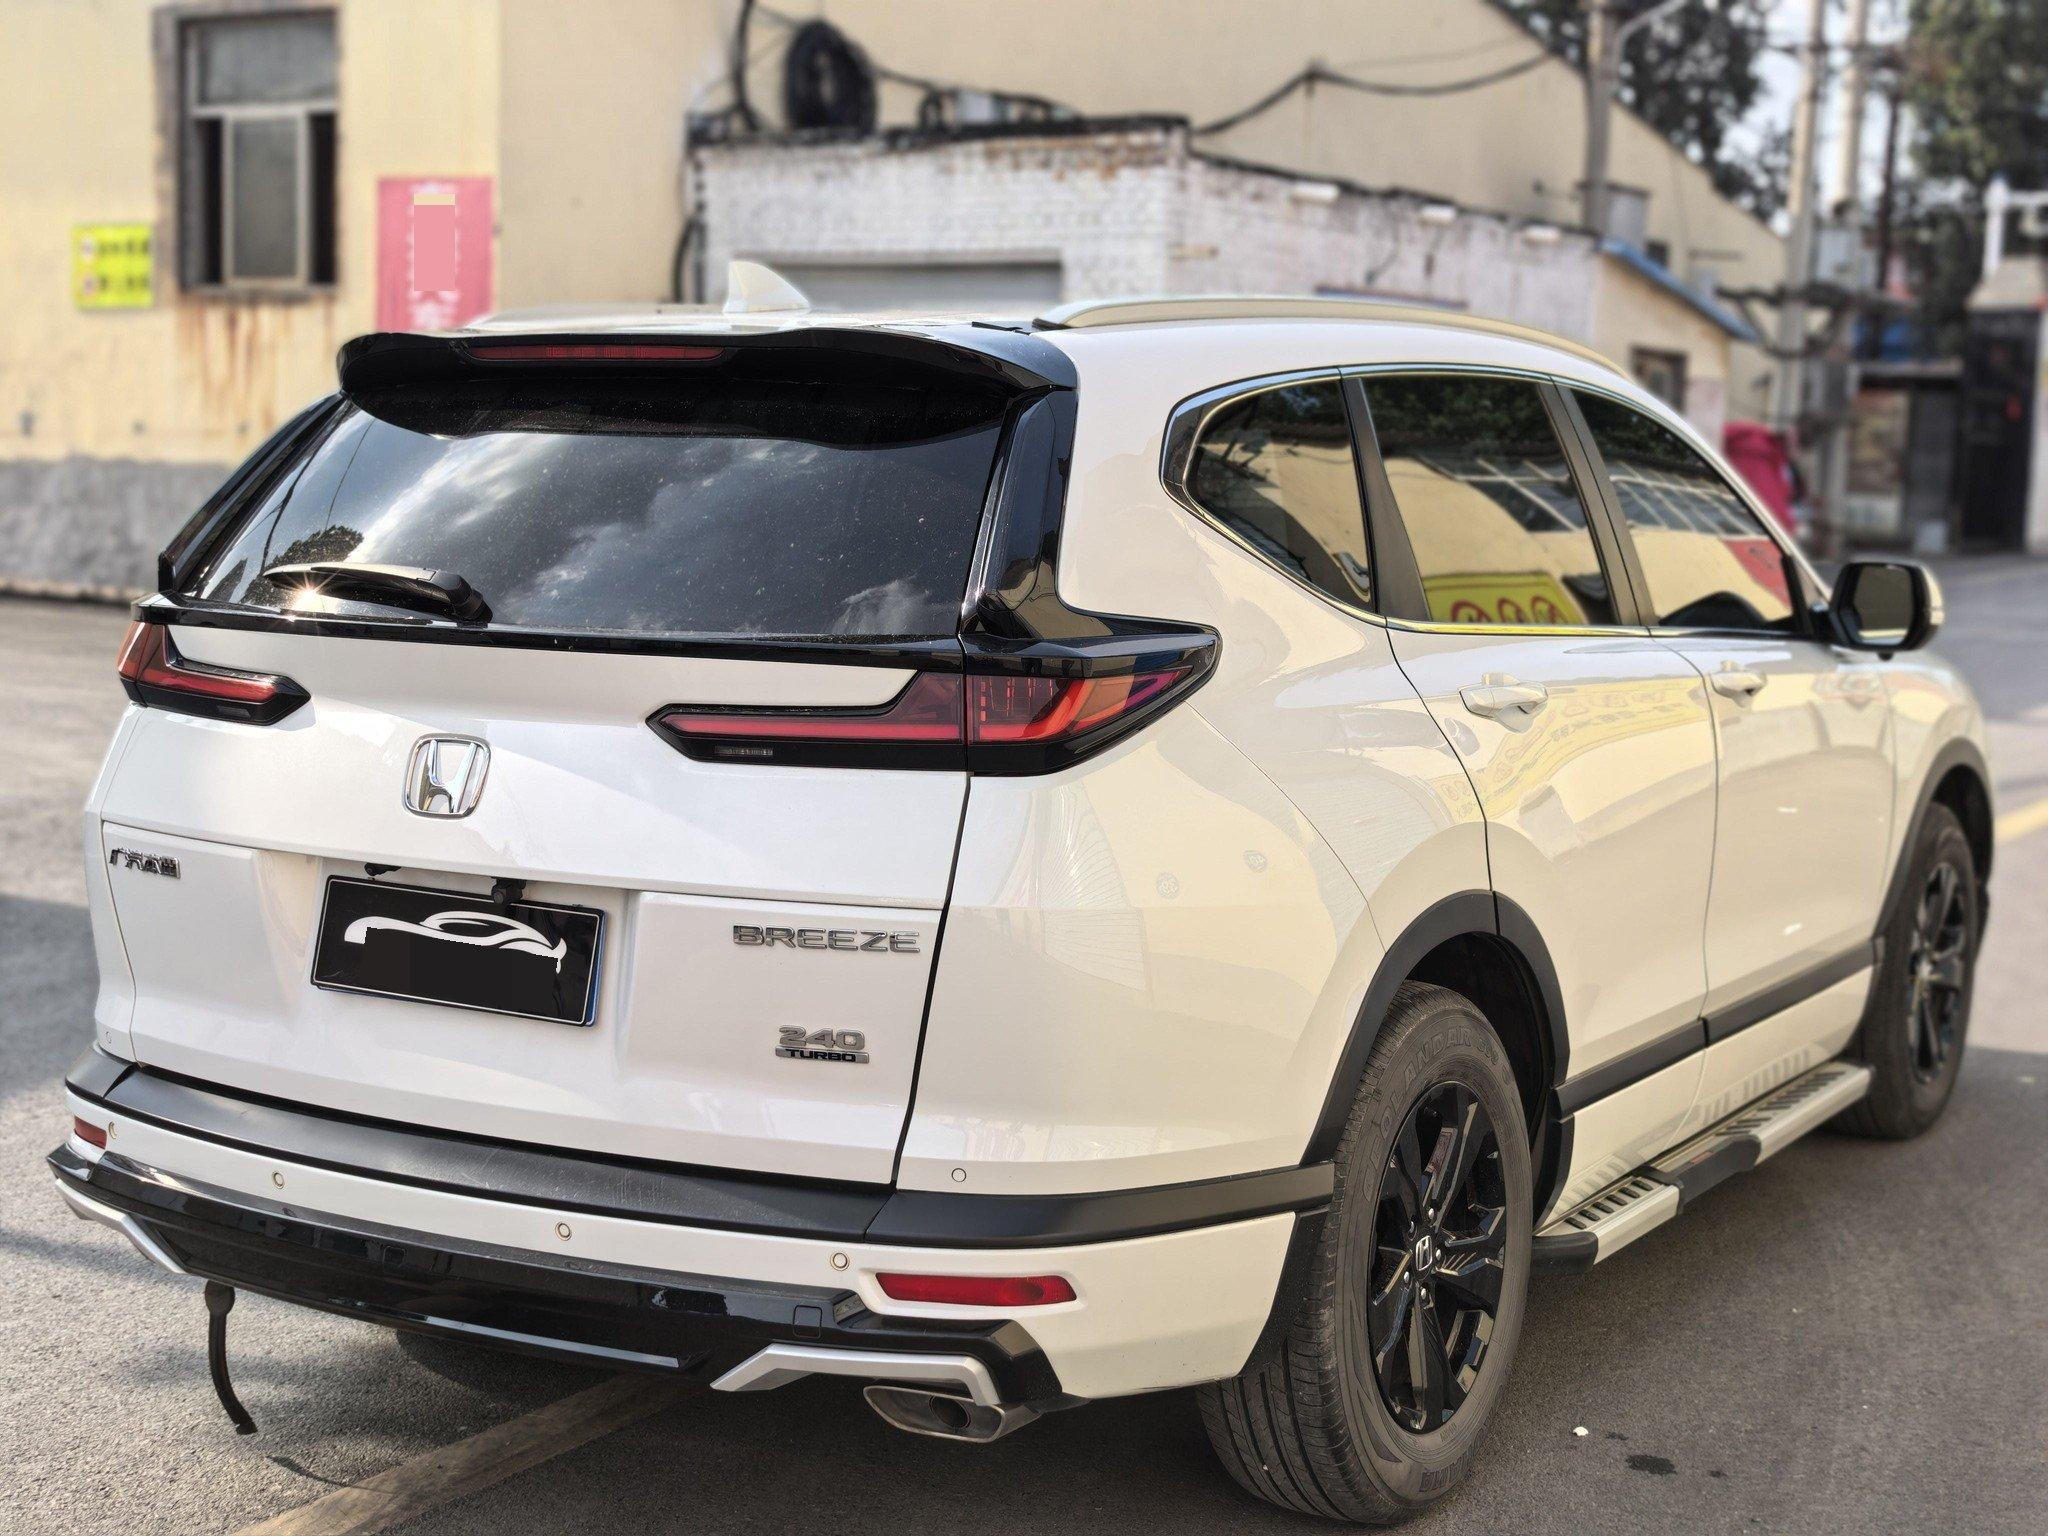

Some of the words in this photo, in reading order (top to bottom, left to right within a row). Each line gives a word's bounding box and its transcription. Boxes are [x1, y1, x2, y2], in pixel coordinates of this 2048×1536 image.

[732, 924, 921, 953] BREEZE
[778, 1024, 866, 1051] 240
[784, 1047, 857, 1063] TURBO
